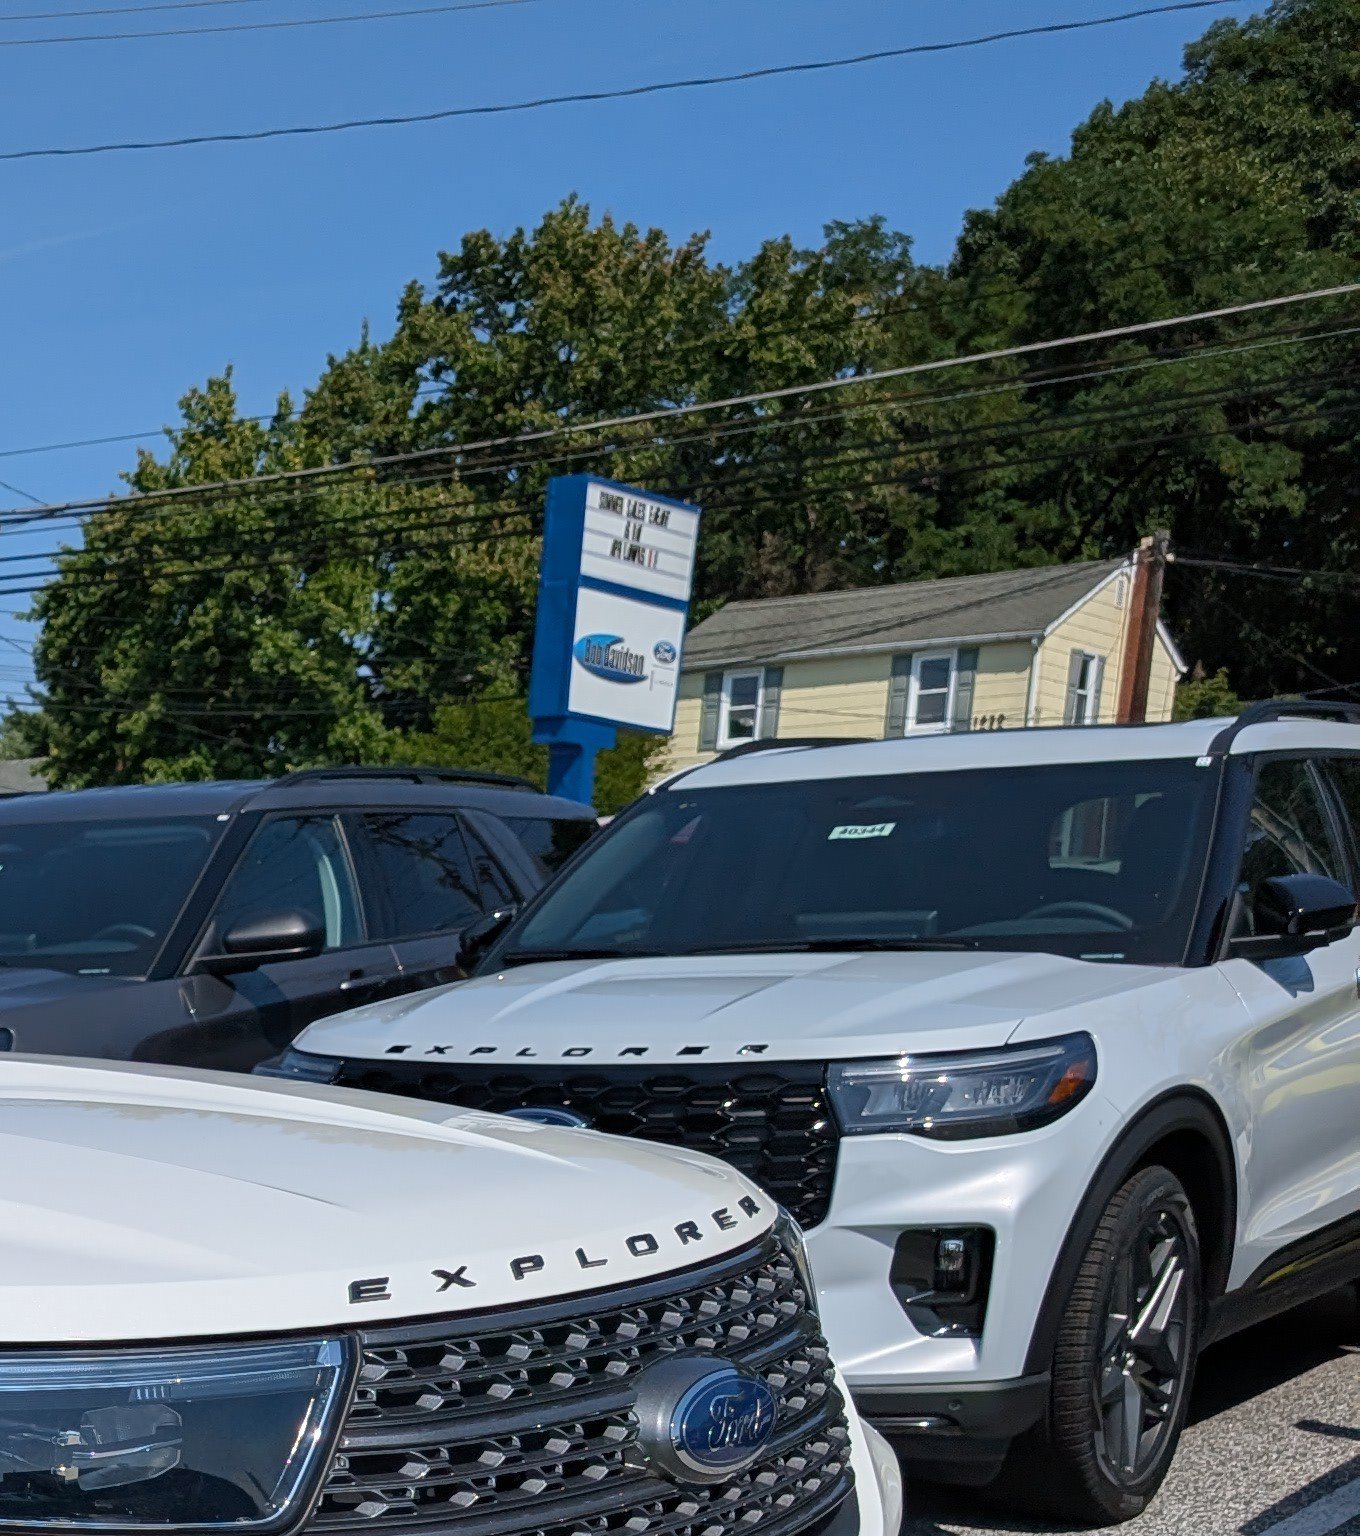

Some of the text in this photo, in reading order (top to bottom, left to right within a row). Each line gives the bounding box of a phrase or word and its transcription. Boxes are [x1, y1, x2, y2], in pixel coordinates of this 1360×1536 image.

[604, 643, 645, 676] Davidson
[385, 1043, 769, 1058] EXPLORER
[348, 1195, 761, 1305] EXPLORER
